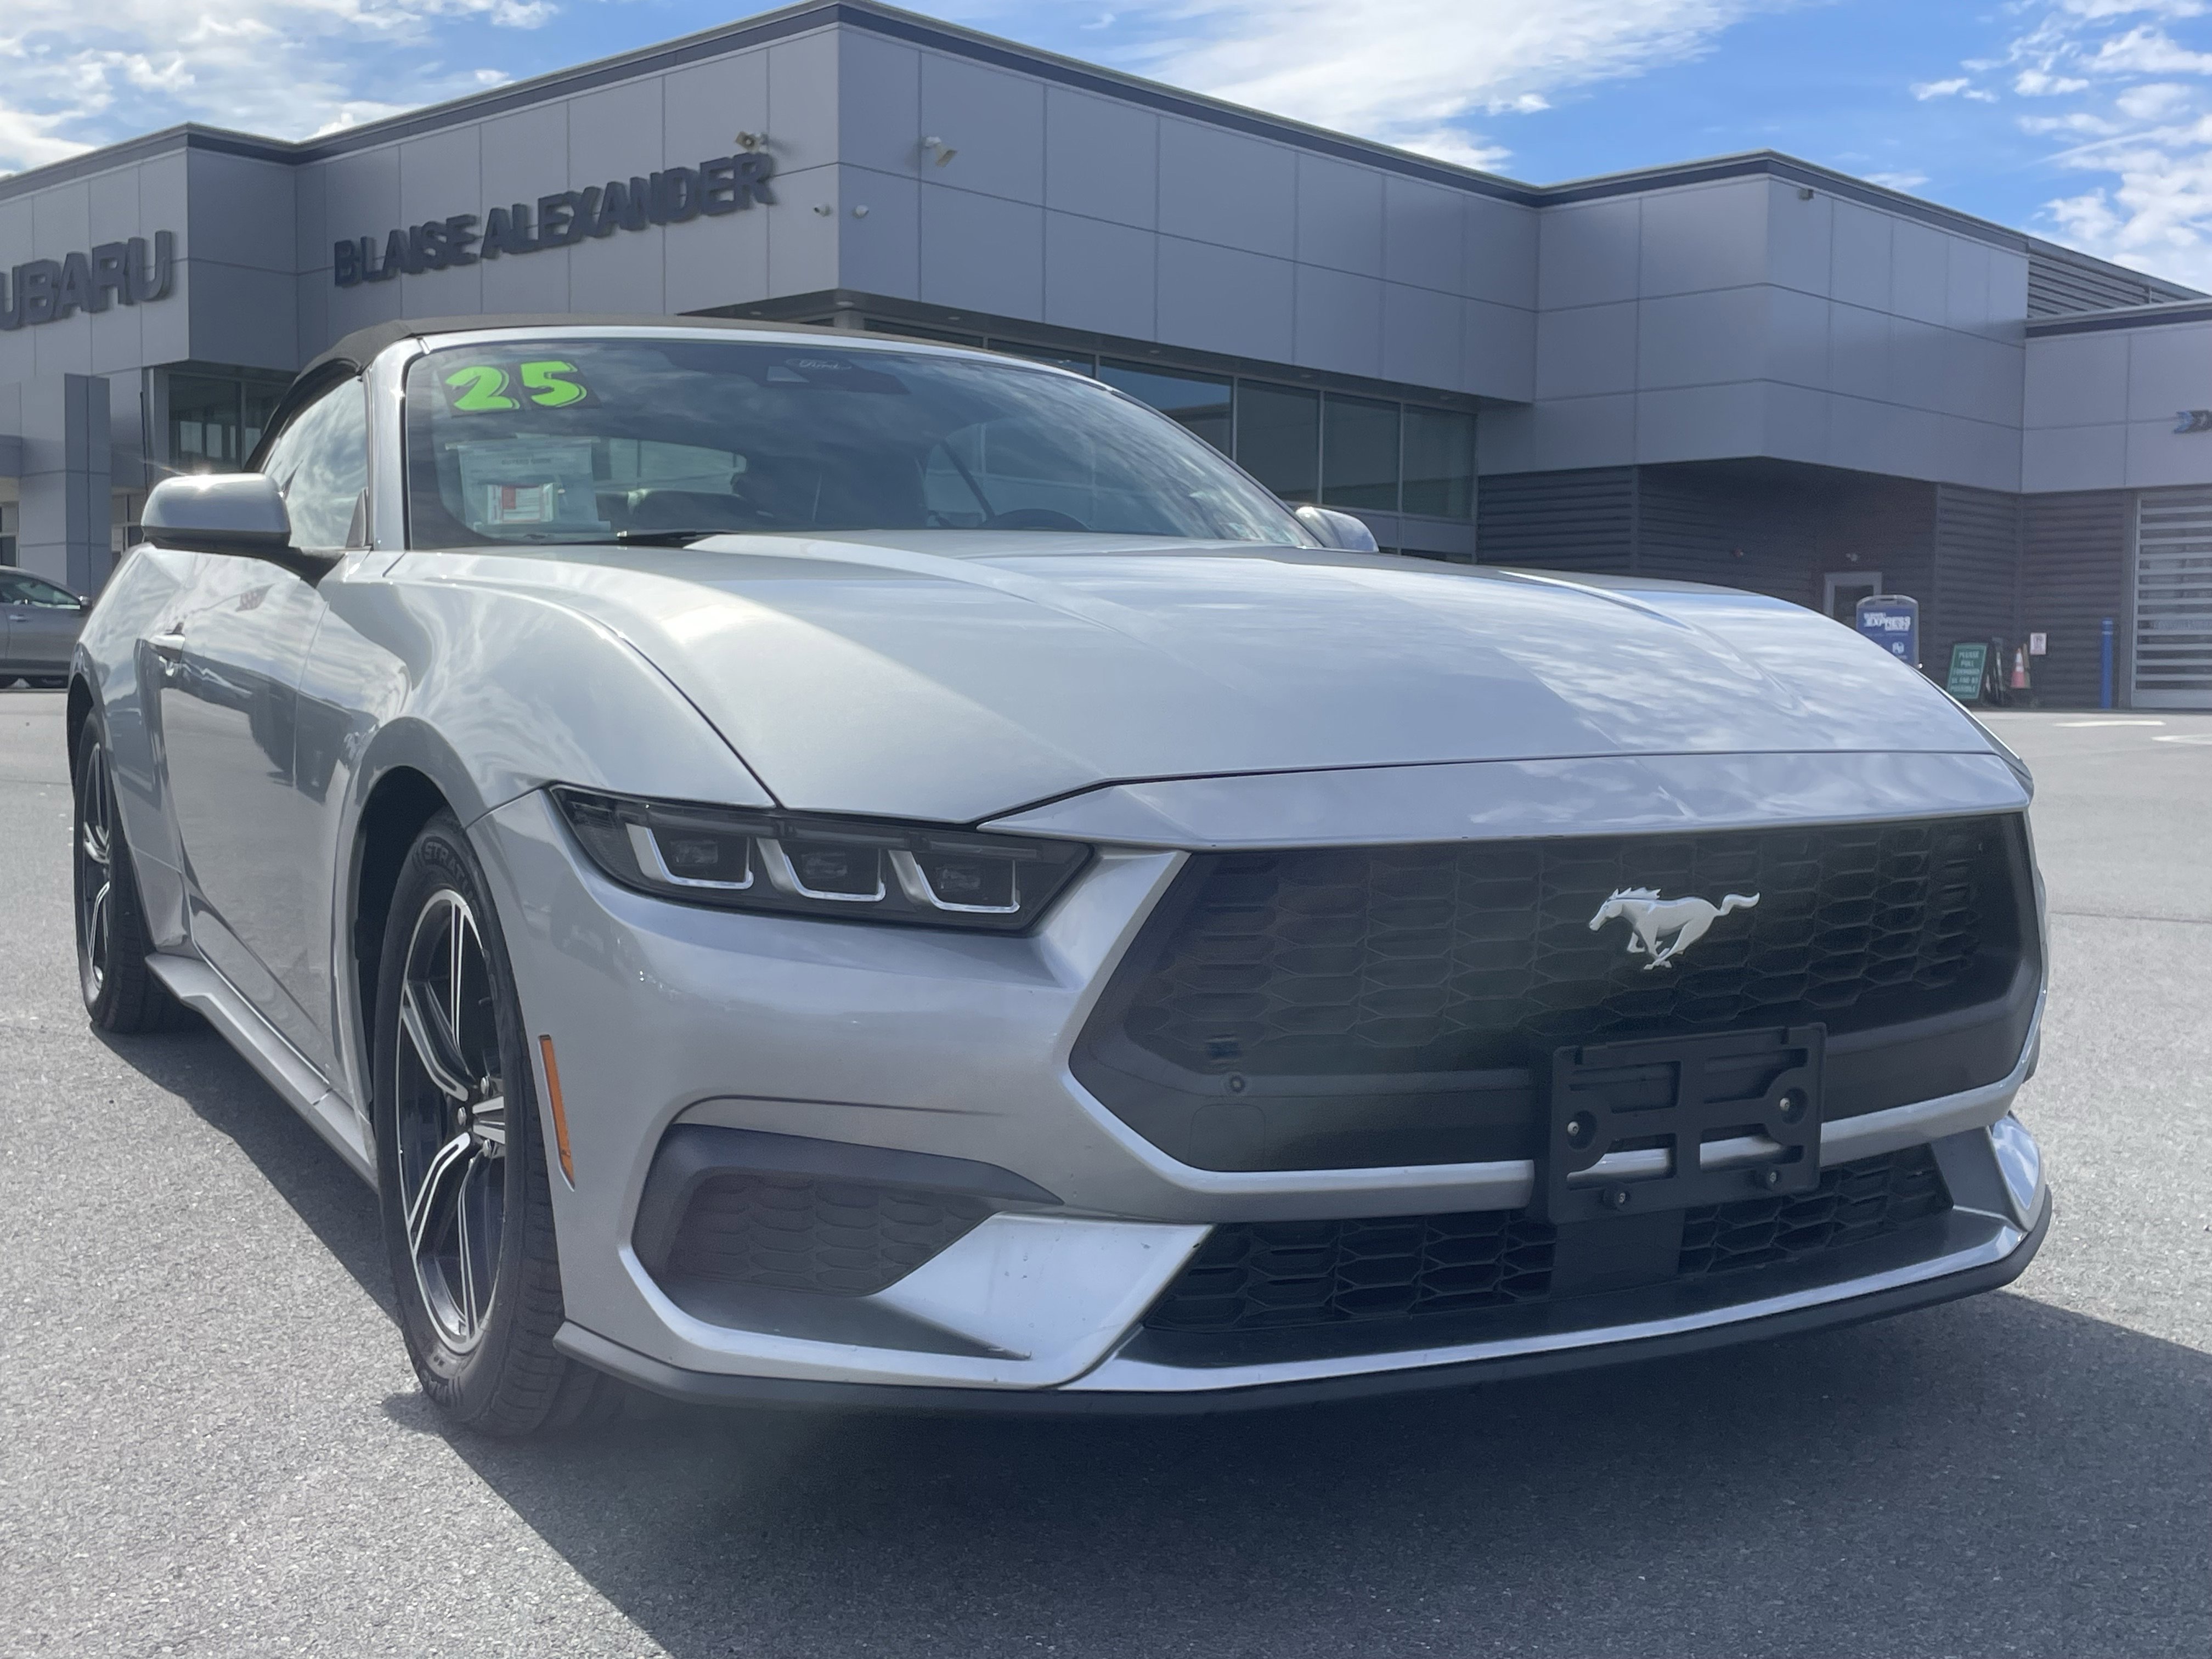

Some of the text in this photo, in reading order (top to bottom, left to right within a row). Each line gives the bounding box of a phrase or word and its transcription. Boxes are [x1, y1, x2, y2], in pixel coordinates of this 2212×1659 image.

[334, 152, 775, 287] BLAISE ALEXANDER
[445, 360, 588, 411] 25
